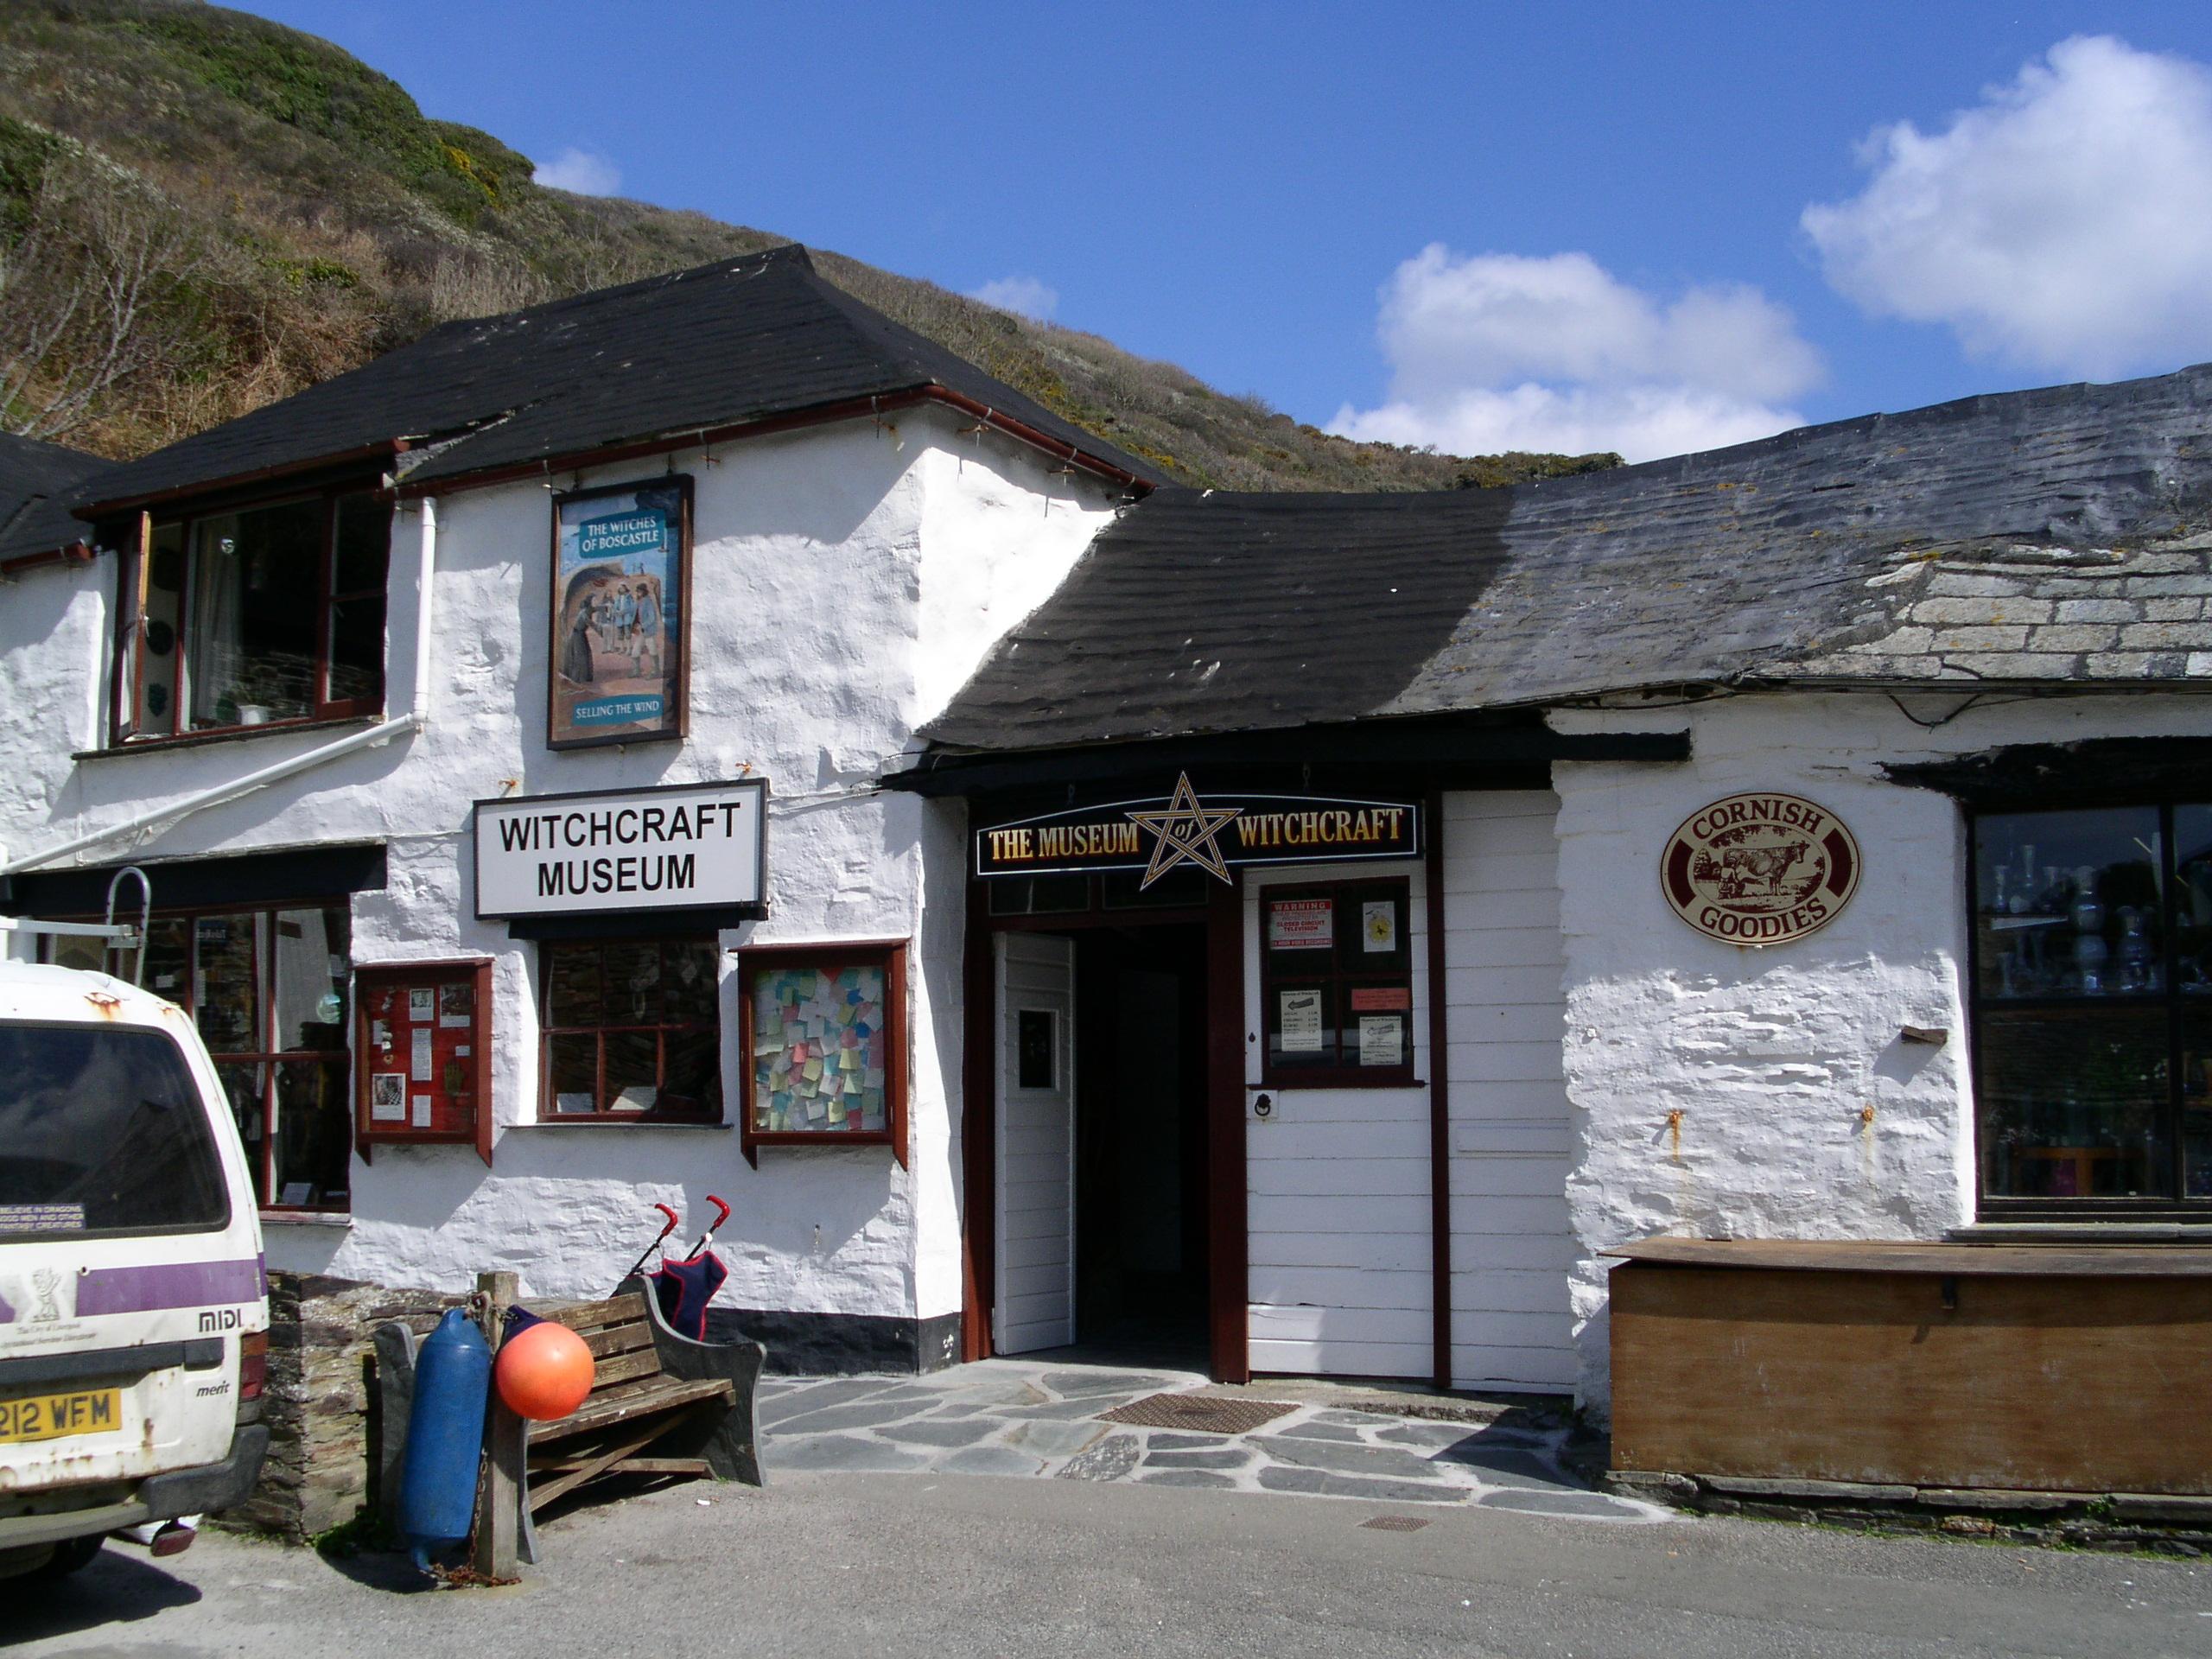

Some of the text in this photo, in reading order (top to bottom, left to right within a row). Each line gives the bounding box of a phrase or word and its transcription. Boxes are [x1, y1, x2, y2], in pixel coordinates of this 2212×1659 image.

[588, 516, 657, 537] THE WITCHES
[582, 530, 659, 553] OF BOSCASTLE
[575, 700, 660, 720] SELLING THE WIND
[499, 802, 741, 852] WITCHCRAFT
[988, 807, 1404, 861] THE MUSEUM of WITCHCRAFT
[1692, 798, 1825, 841] CORNISH
[537, 853, 696, 897] MUSEUM
[1274, 901, 1326, 912] WARNING
[1700, 897, 1828, 938] GOODIES
[199, 1308, 242, 1332] MIDI
[196, 1381, 231, 1397] merit
[51, 1393, 111, 1428] WFM
